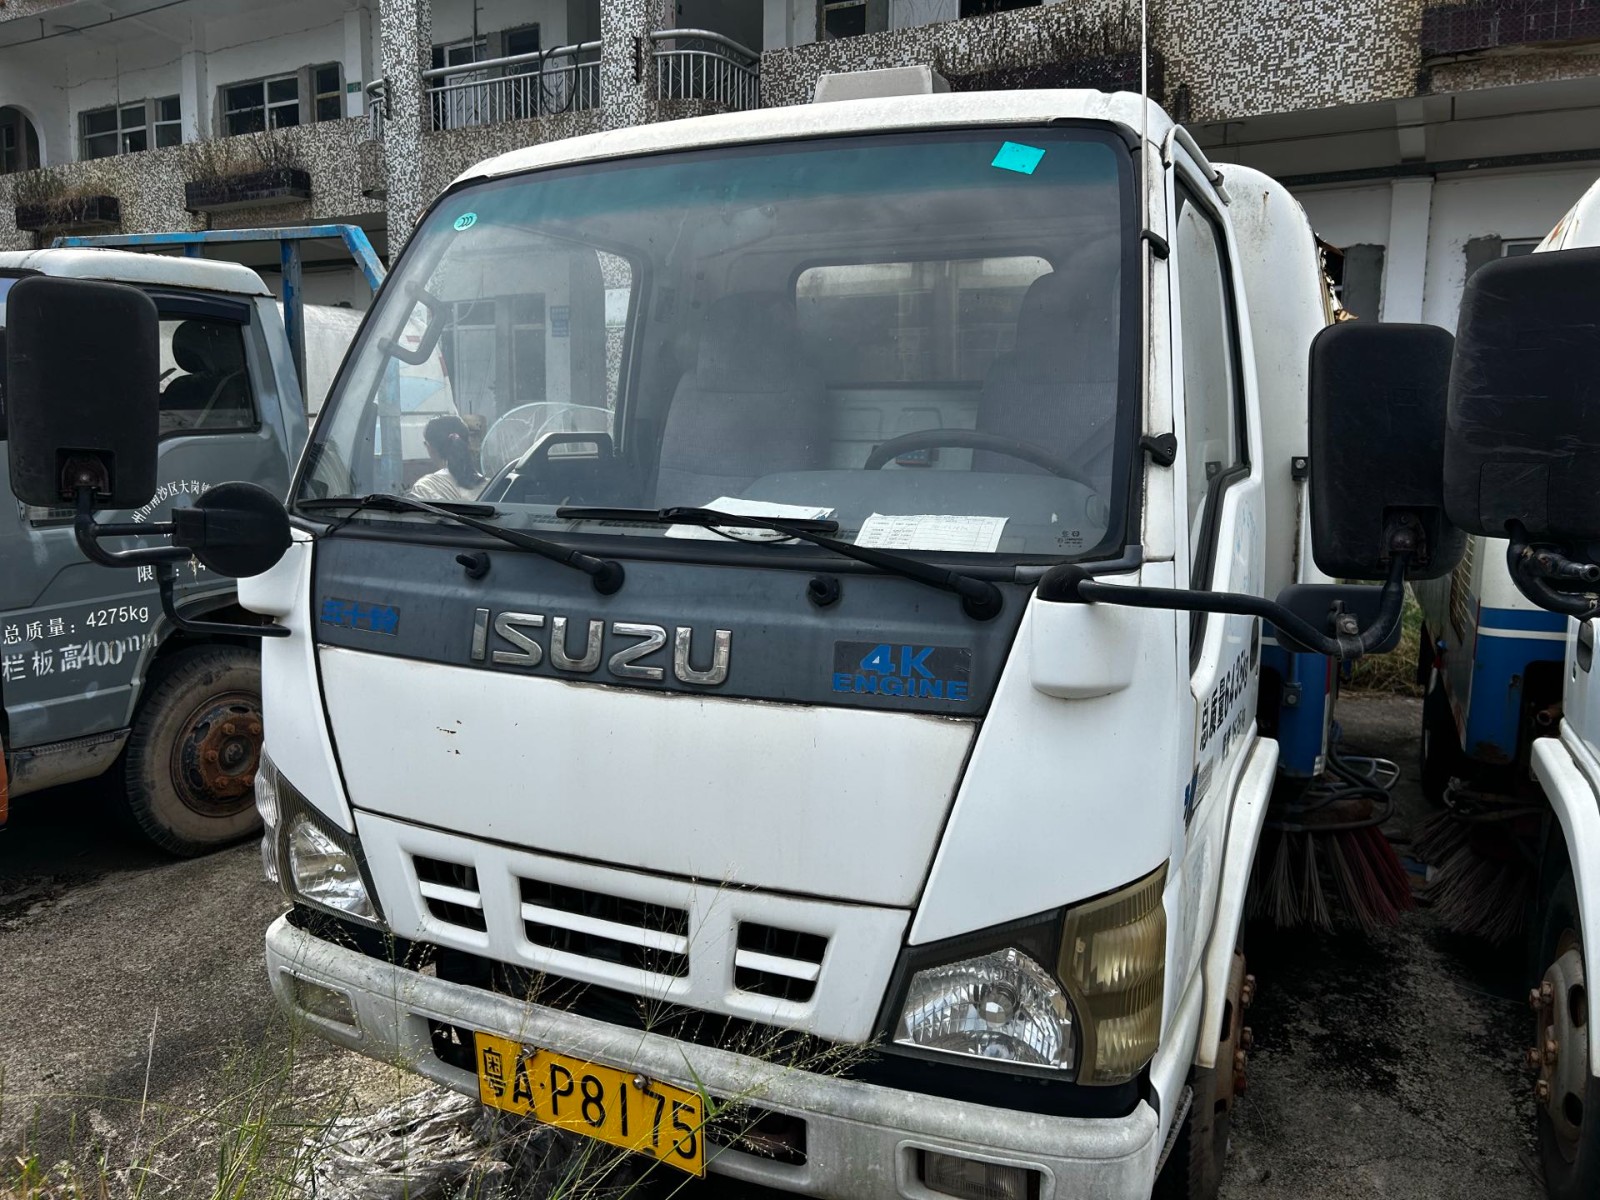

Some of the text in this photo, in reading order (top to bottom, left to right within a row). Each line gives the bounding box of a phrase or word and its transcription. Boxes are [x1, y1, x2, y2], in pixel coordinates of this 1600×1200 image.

[86, 605, 149, 628] 4275kg
[471, 608, 732, 685] ISUZU
[860, 644, 935, 679] 4K
[832, 672, 969, 701] ENGINE
